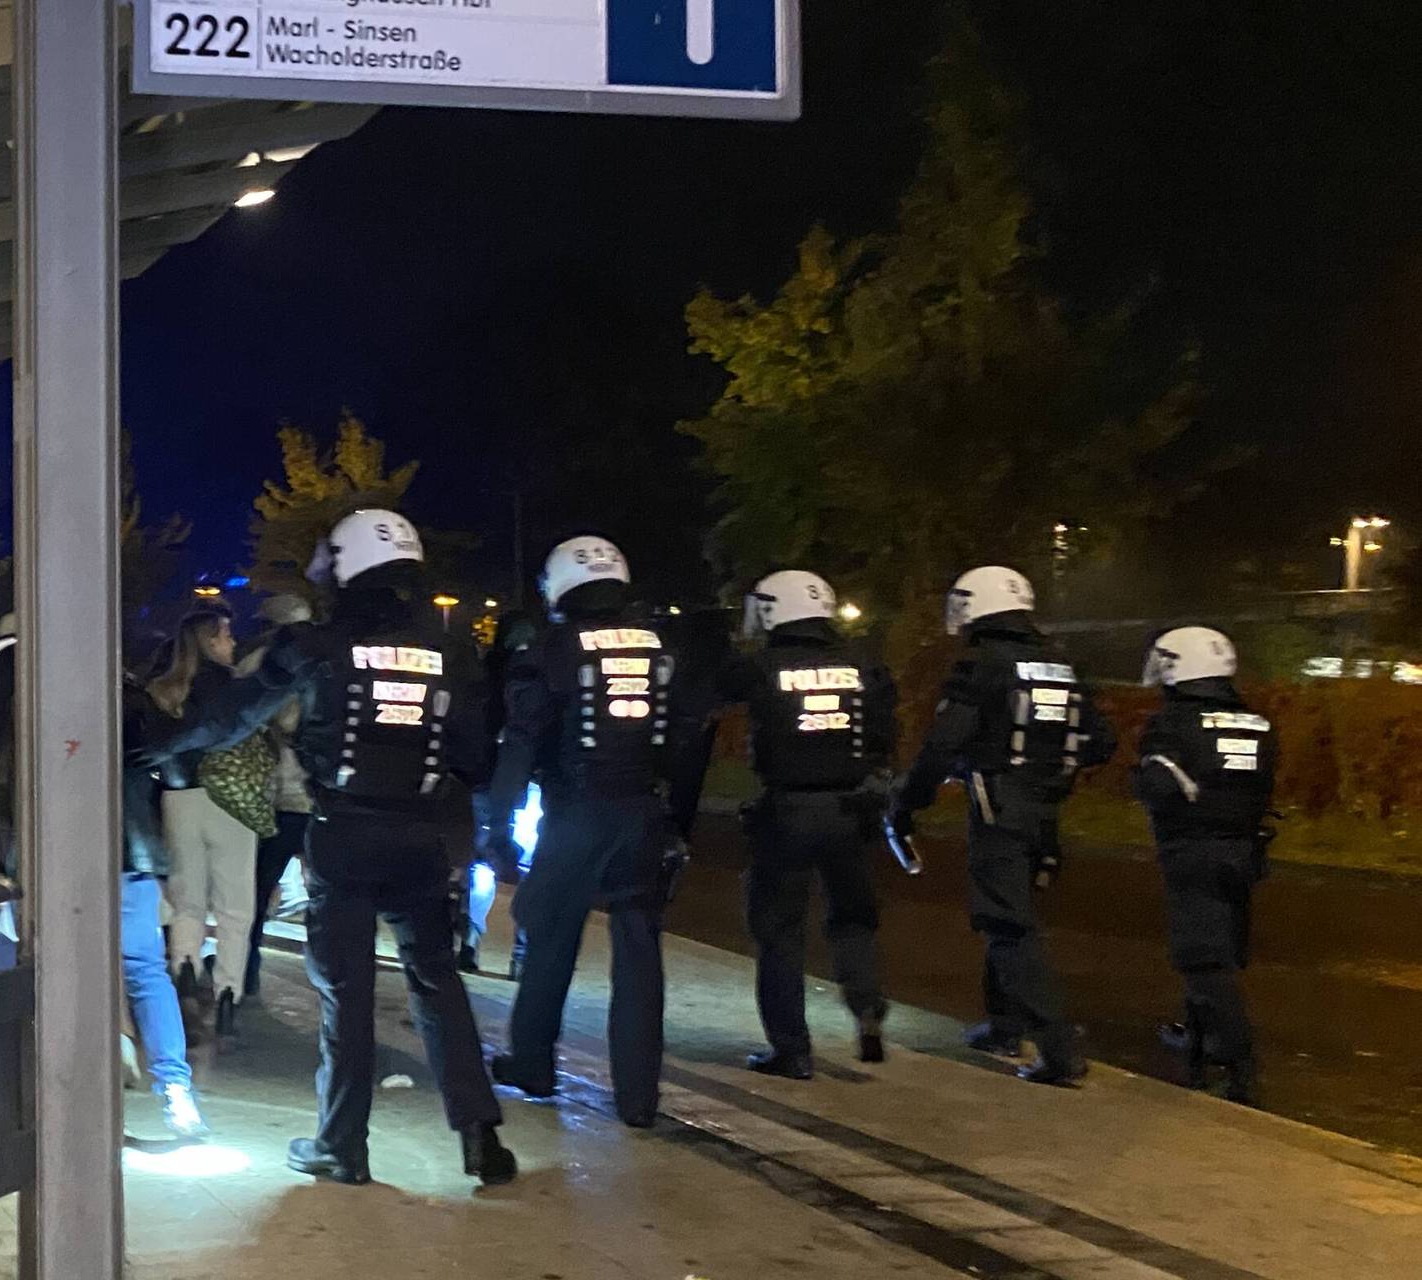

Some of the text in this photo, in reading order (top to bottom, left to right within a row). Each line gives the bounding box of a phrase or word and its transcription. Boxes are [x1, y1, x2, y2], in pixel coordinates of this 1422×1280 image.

[164, 13, 251, 60] 222
[266, 16, 319, 38] Marl
[344, 20, 417, 43] Sinsen
[266, 43, 462, 72] Wacholderstraße
